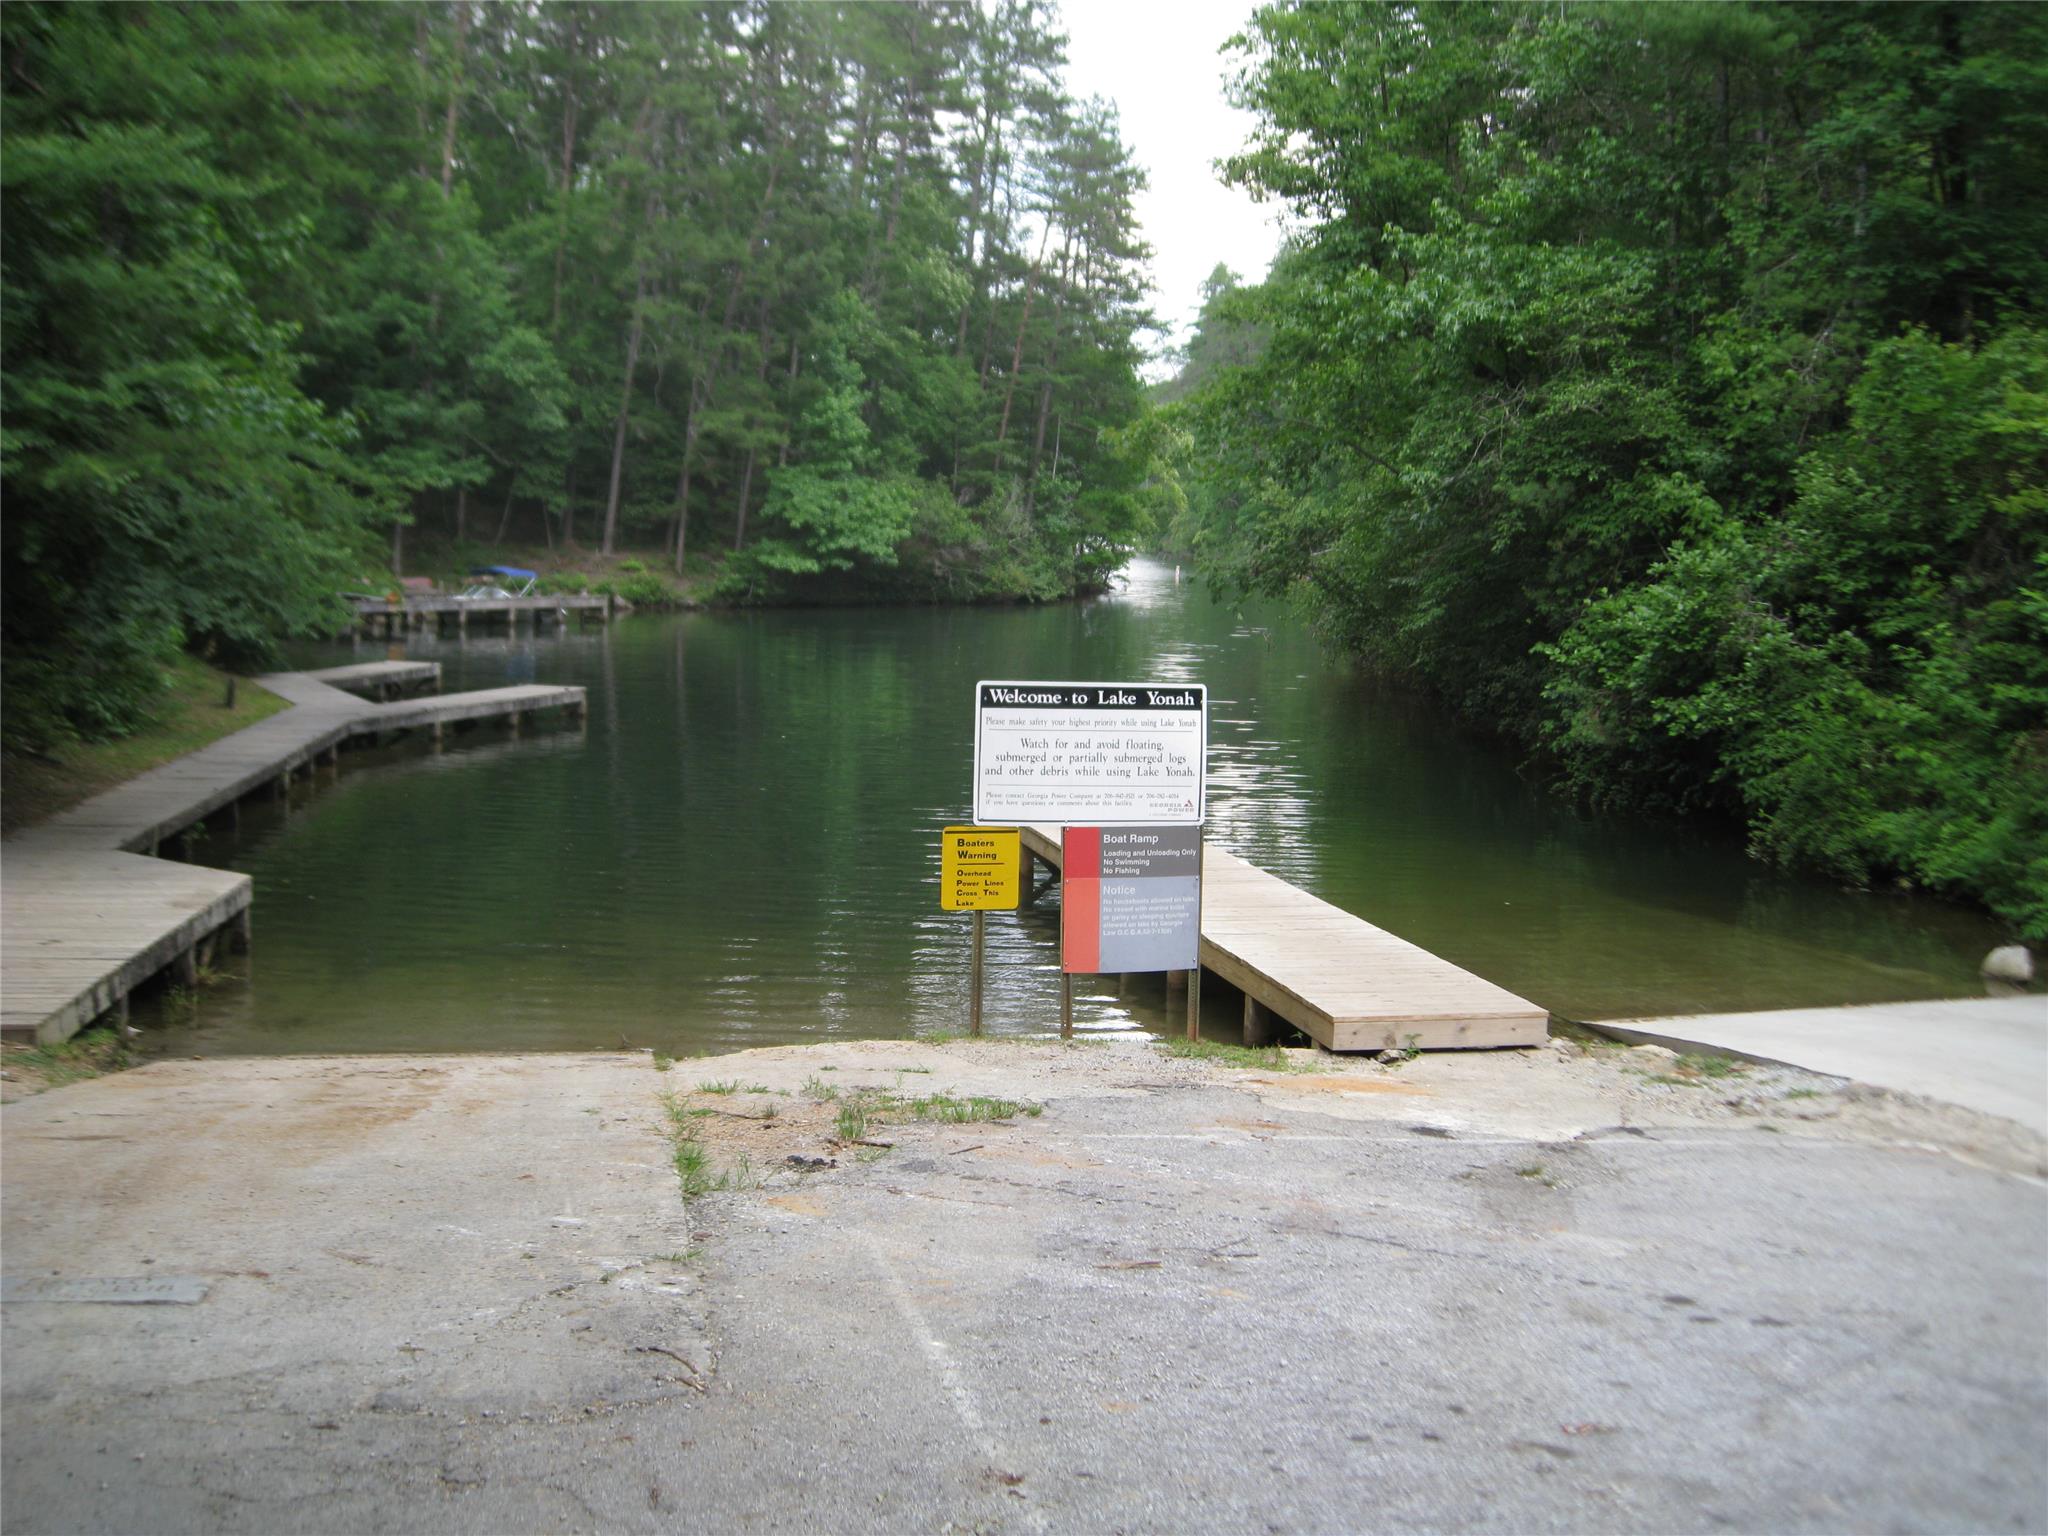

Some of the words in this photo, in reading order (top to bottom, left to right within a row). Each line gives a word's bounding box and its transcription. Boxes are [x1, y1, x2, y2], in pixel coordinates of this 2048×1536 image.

[989, 688, 1062, 704] Welcome
[1072, 692, 1088, 704] to
[1098, 690, 1137, 705] Lake
[1146, 691, 1195, 706] Yonah
[985, 716, 1005, 726] Please
[1009, 717, 1026, 726] make
[1029, 717, 1048, 728] safety
[1051, 719, 1066, 728] your
[1069, 717, 1091, 728] highest
[1094, 718, 1117, 728] priority
[1121, 718, 1138, 727] while
[1140, 719, 1157, 728] using
[1160, 718, 1175, 727] Lake
[1179, 718, 1197, 728] Yonah
[1021, 738, 1049, 749] Watch
[1055, 738, 1068, 749] for
[1074, 738, 1091, 749] and
[1096, 738, 1120, 750] avoid
[1126, 738, 1165, 752] floating,
[995, 751, 1047, 764] submerged
[1052, 754, 1063, 763] or
[1069, 752, 1108, 765] partially
[1114, 752, 1163, 766] submerged
[1168, 752, 1187, 765] logs
[984, 764, 1003, 776] and
[1008, 765, 1035, 776] other
[1040, 765, 1069, 776] debris
[1075, 766, 1101, 777] while
[1106, 766, 1132, 779] using
[1137, 766, 1160, 777] Lake
[1166, 766, 1195, 777] Yonah.
[957, 838, 995, 847] Boaters
[1103, 834, 1127, 844] Boat
[1129, 834, 1159, 845] Ramp
[957, 850, 997, 860] Warning
[1103, 849, 1131, 858] Loading
[1147, 848, 1180, 857] Unloading
[1181, 848, 1196, 857] Only
[1114, 858, 1150, 866] Swimming
[956, 869, 992, 877] Overhead
[1115, 867, 1140, 875] Fishing
[956, 889, 978, 897] Cross
[1103, 885, 1136, 895] Notice
[956, 899, 974, 907] Lake
